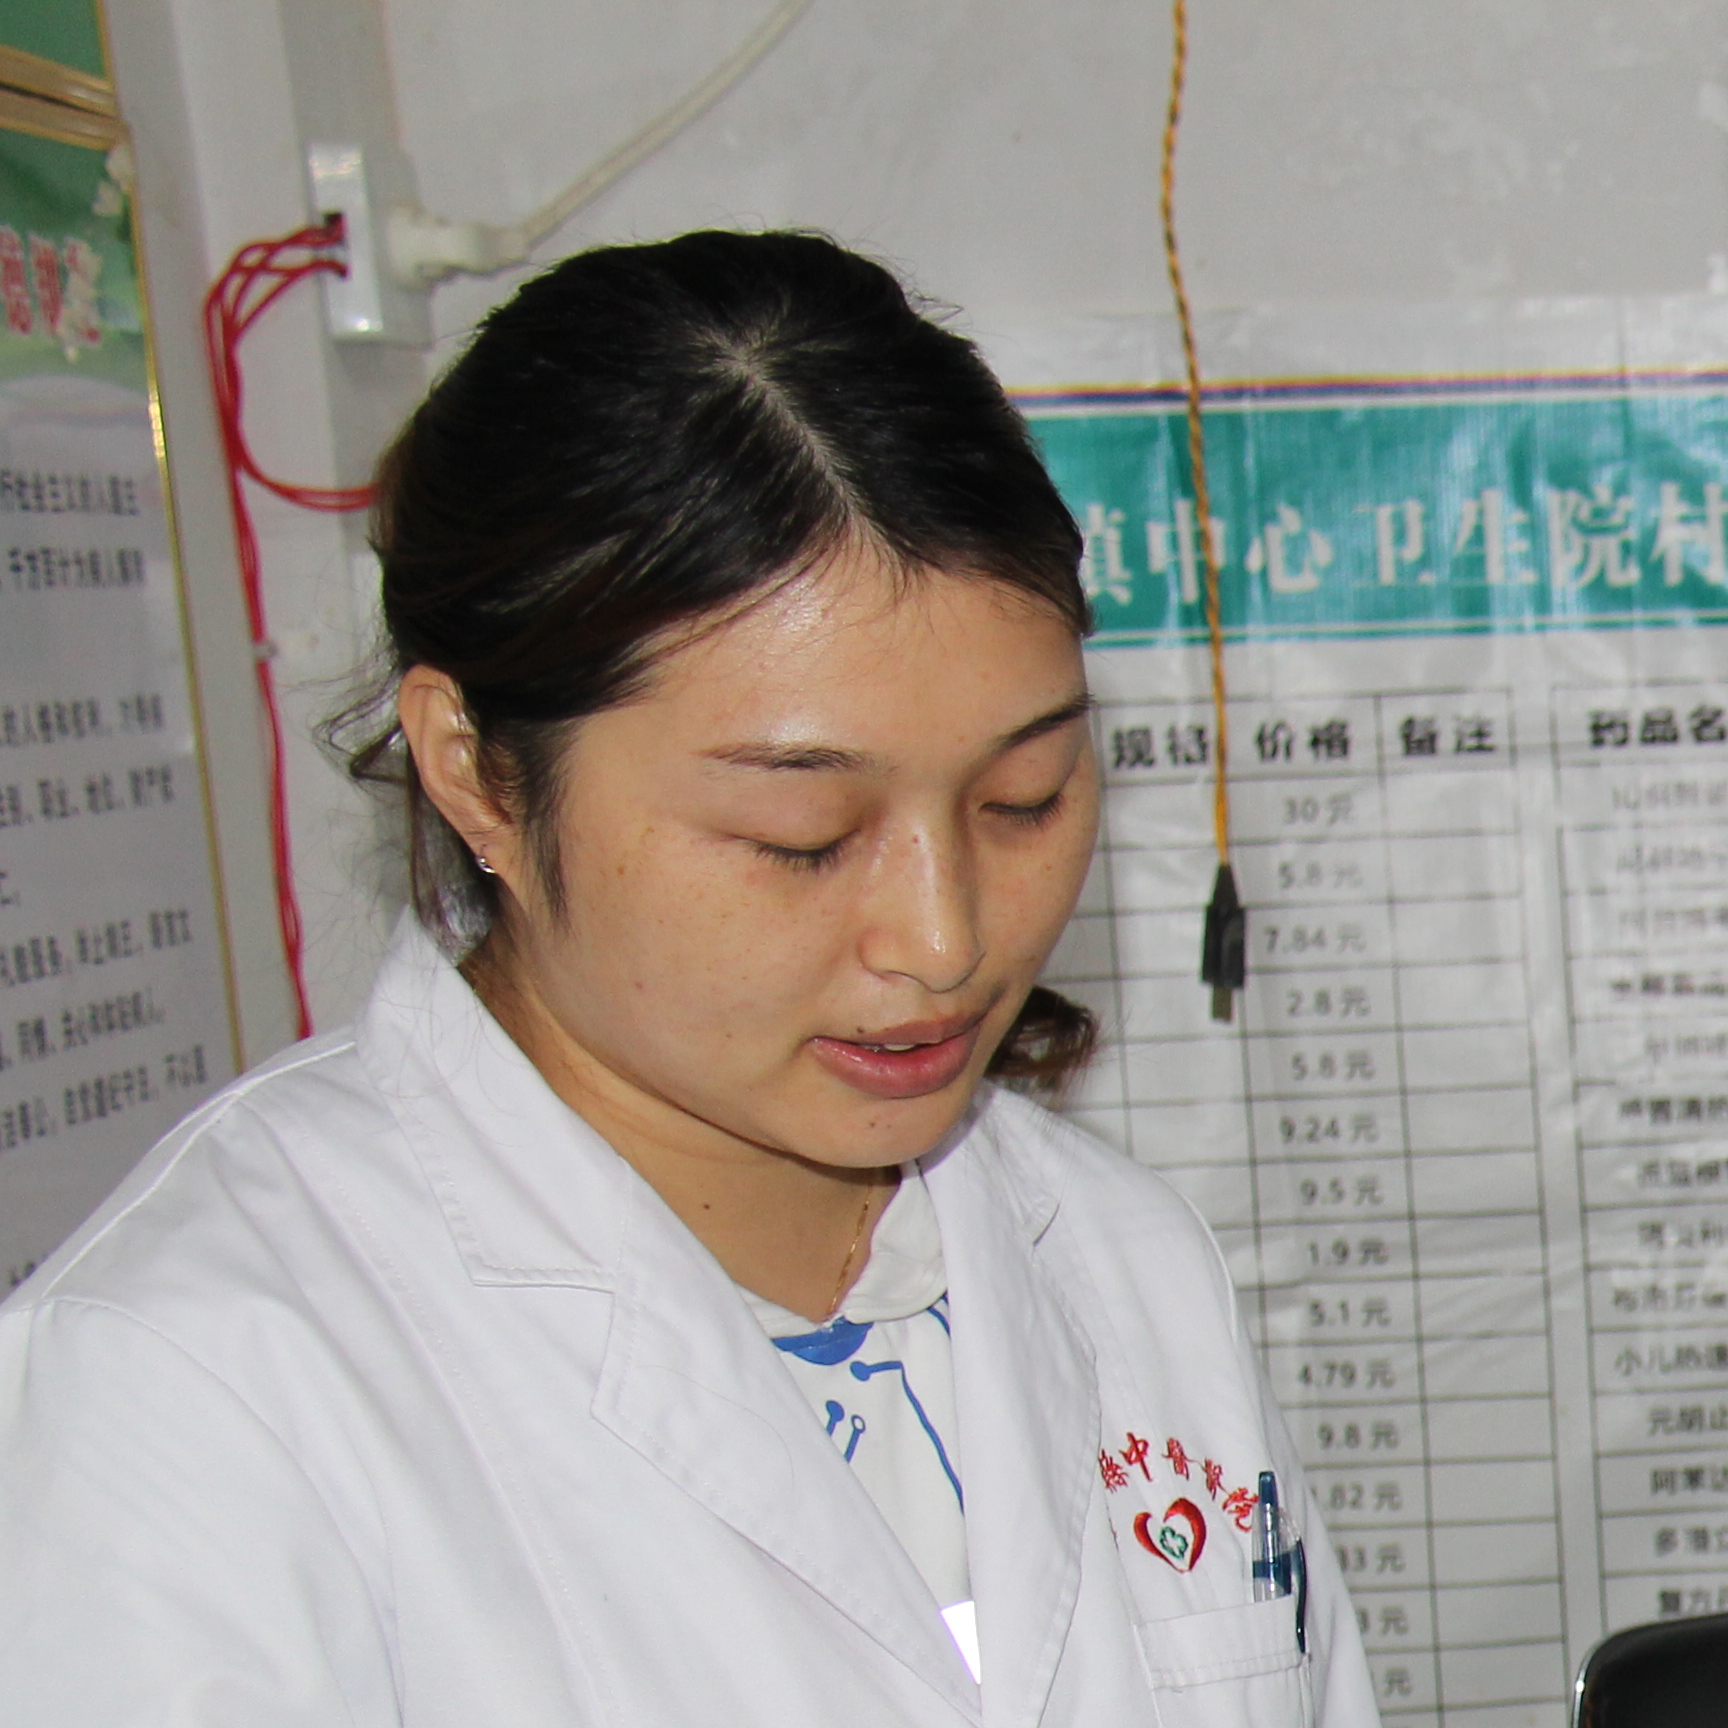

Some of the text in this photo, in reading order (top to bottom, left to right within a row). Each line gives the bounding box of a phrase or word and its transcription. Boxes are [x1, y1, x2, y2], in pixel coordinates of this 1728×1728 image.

[1256, 720, 1350, 763] 价格
[1400, 714, 1495, 755] 备注
[1286, 987, 1370, 1017] 2.8元
[1279, 1115, 1377, 1147] 9.24元
[1300, 1177, 1384, 1208] 9.5元
[1307, 1238, 1389, 1269] 1.9元
[1308, 1298, 1392, 1329] 5.1元
[1296, 1359, 1395, 1391] 4.79元
[1317, 1421, 1399, 1451] 9.8元
